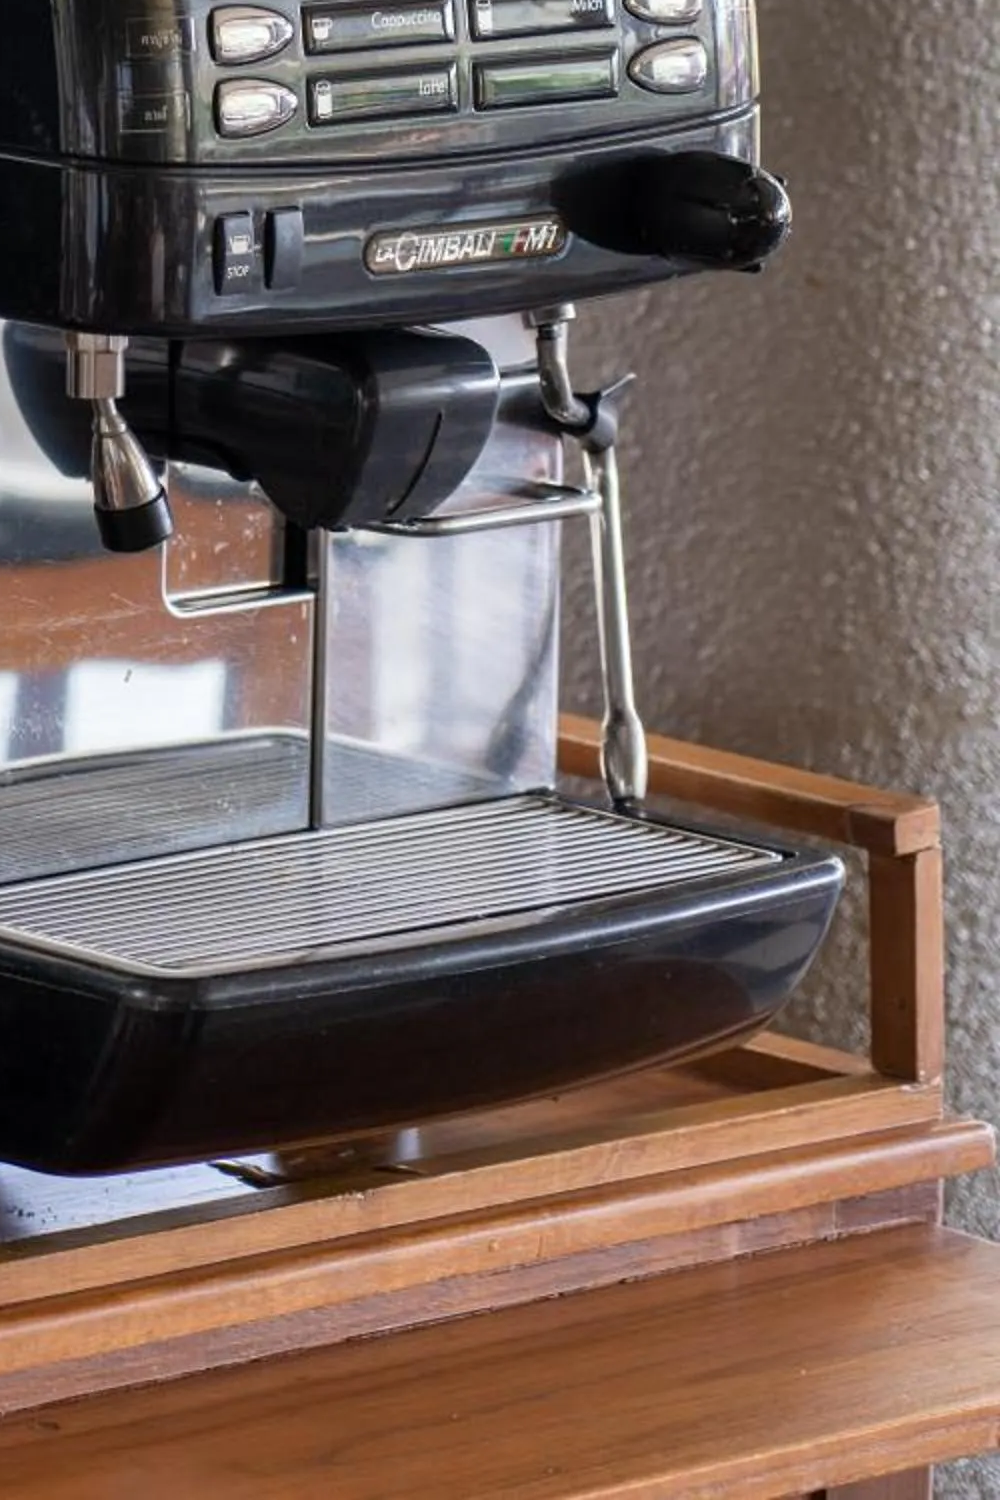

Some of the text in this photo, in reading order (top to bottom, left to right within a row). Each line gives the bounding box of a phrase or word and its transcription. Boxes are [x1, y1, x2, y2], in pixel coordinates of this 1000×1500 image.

[371, 9, 442, 30] Cappuccino
[395, 231, 497, 271] CIMBALI
[523, 224, 559, 252] M1
[227, 265, 250, 280] STOP
